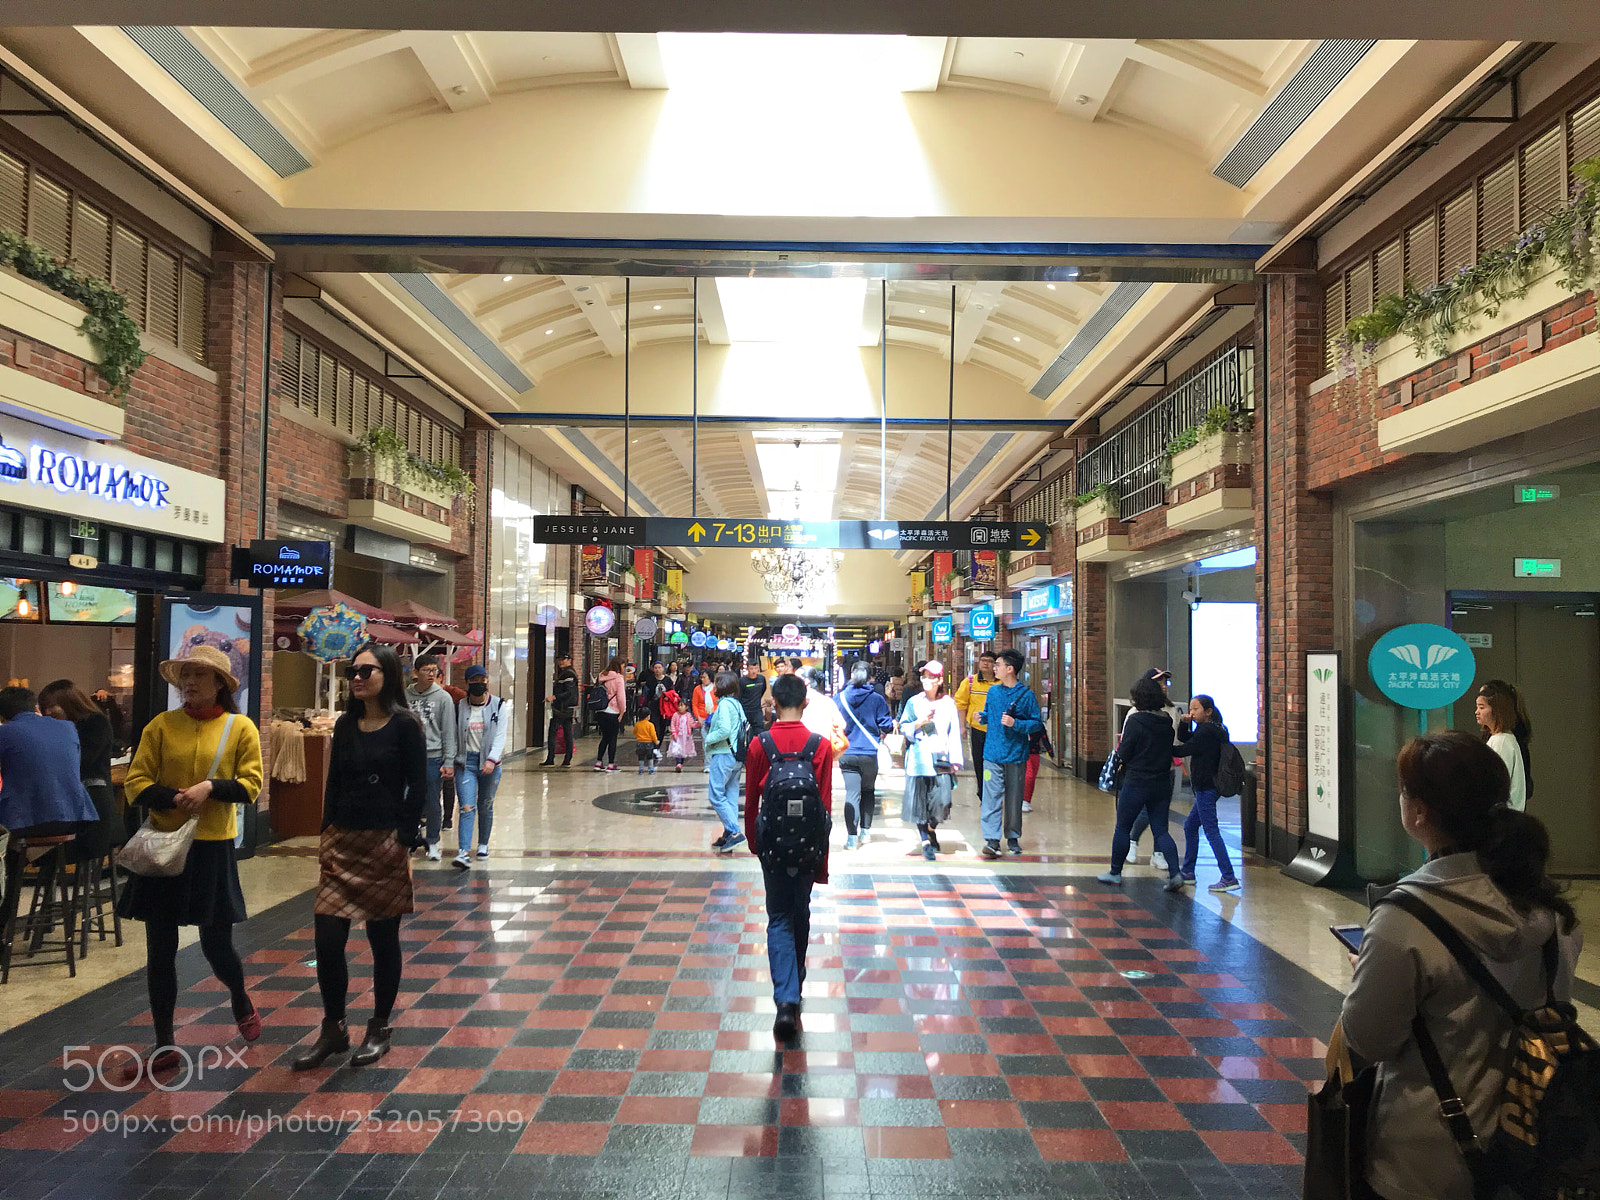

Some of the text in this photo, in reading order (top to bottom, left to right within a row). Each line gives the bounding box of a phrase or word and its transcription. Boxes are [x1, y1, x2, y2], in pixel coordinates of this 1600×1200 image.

[38, 448, 171, 507] ROMAMOR
[544, 525, 635, 535] JESSIE & JANE
[712, 523, 755, 543] 7-13
[758, 524, 782, 538] 出口
[990, 528, 1011, 539] 地铁
[253, 563, 324, 576] ROMAMOR
[1443, 681, 1460, 689] CITY
